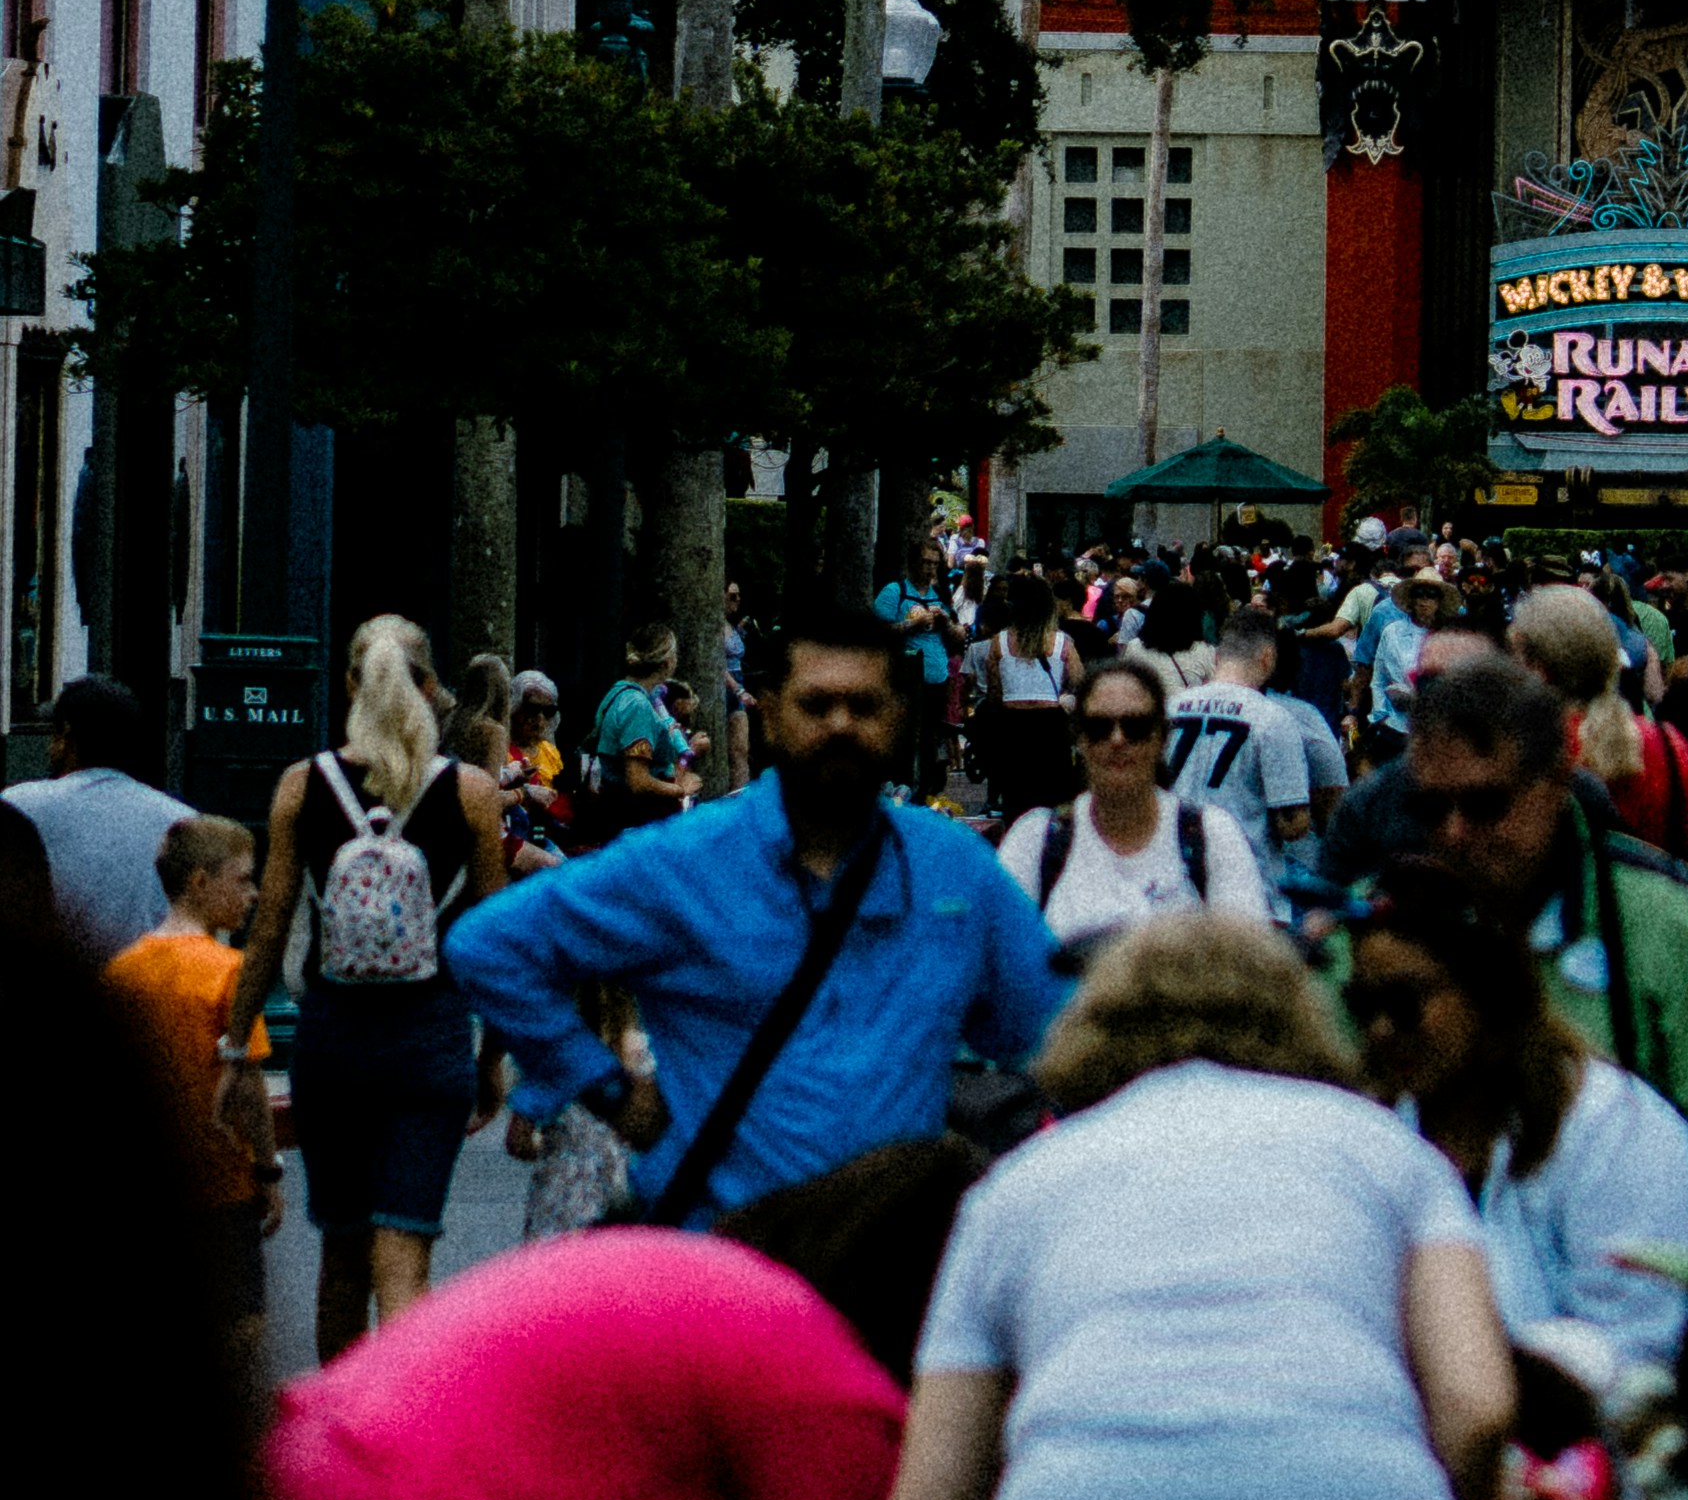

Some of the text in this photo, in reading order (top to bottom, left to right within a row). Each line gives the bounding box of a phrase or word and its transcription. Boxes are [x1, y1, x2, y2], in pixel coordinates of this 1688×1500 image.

[1499, 265, 1636, 314] MICKEY
[1642, 263, 1670, 298] &
[229, 647, 282, 657] LETTERS
[247, 708, 305, 723] MAIL
[1160, 716, 1251, 790] 77
